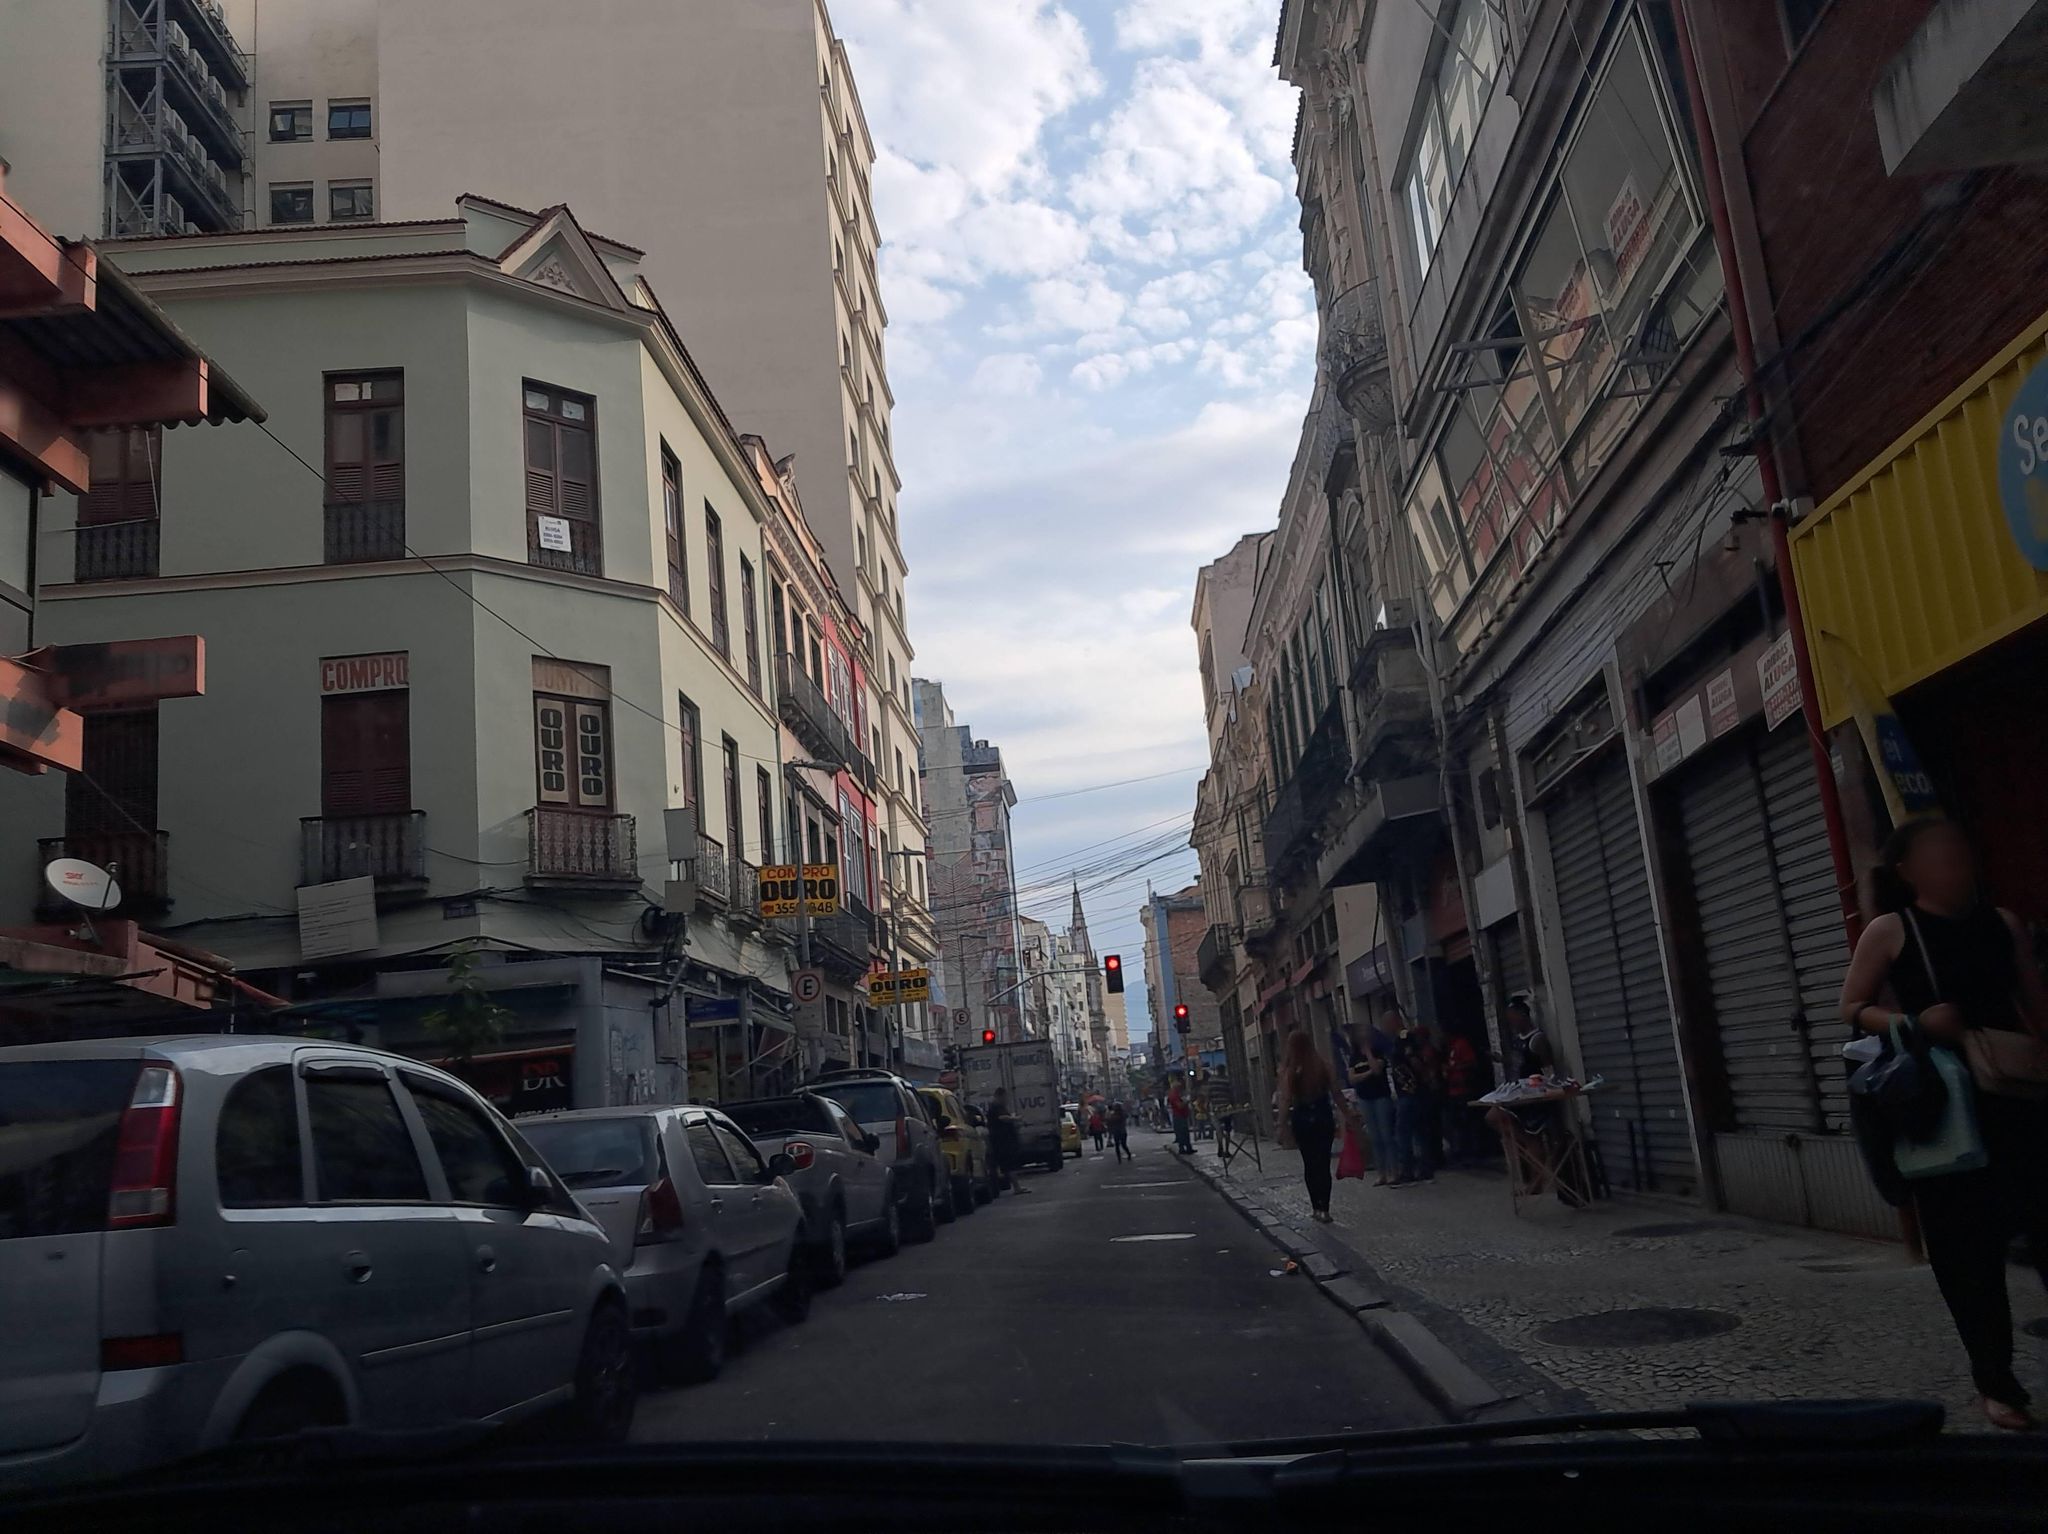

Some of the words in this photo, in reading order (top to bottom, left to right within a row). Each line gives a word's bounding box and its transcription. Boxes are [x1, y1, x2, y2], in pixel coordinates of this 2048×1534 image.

[322, 656, 409, 691] COMPRO
[1764, 654, 1796, 693] ALUGA
[540, 708, 565, 792] OURO
[579, 714, 604, 795] OURO
[761, 878, 836, 901] OURO
[803, 979, 813, 995] E
[871, 977, 927, 992] OURO
[958, 1013, 965, 1022] E
[1018, 1096, 1046, 1109] VUC
